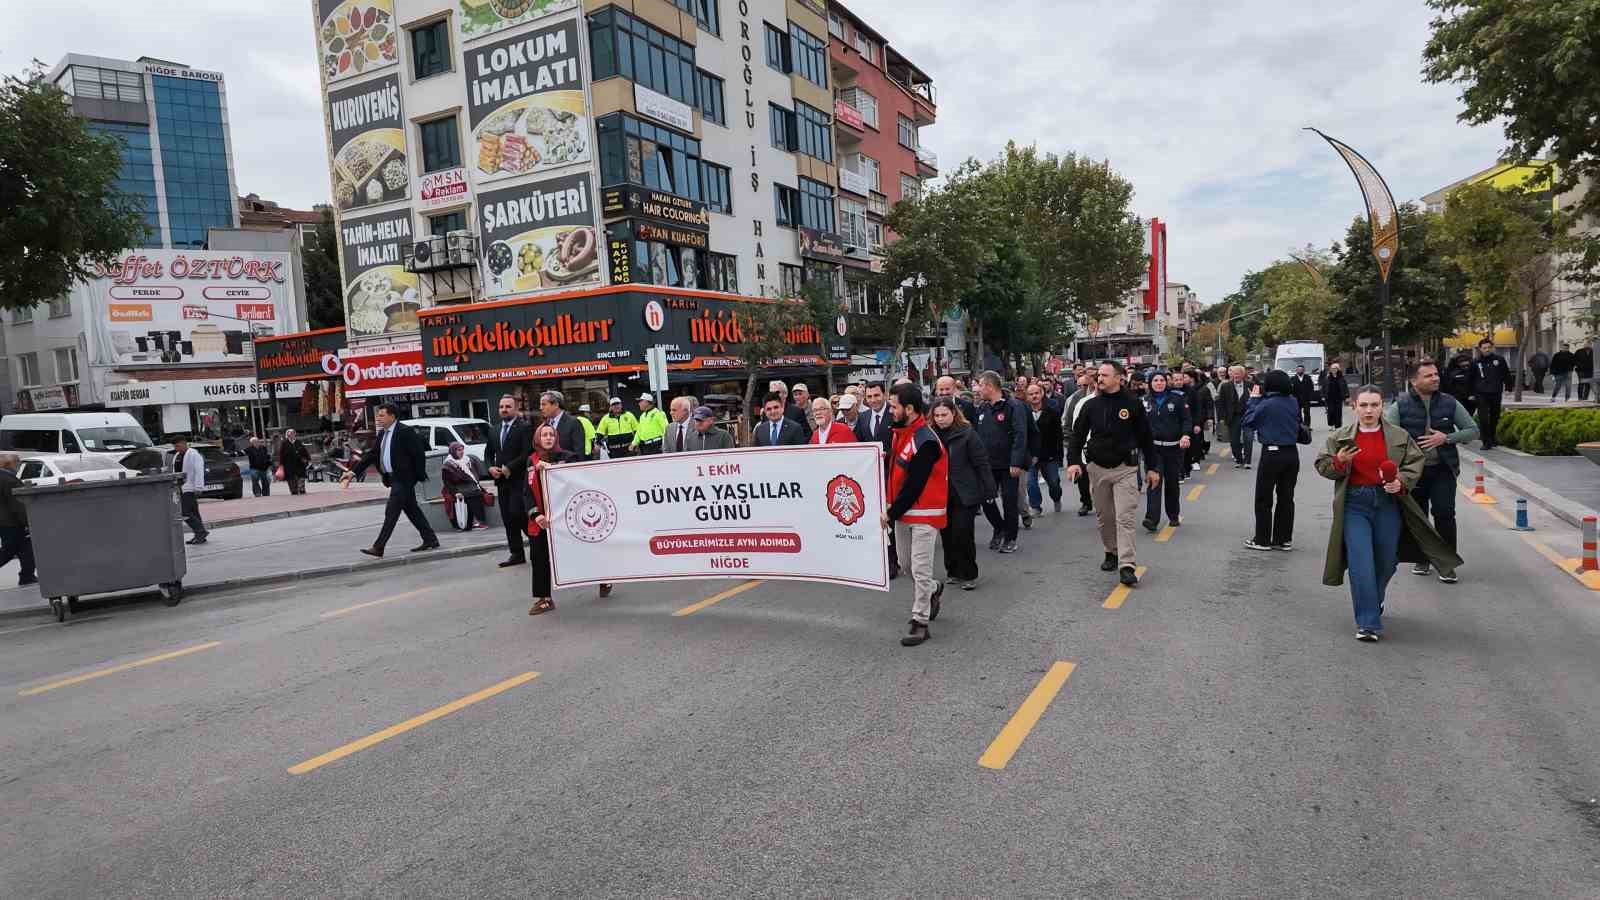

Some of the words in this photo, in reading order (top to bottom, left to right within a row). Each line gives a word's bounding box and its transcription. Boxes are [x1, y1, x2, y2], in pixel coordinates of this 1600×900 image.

[477, 30, 567, 77] LOKUM
[181, 70, 222, 81] BAROSU
[472, 58, 578, 106] İMALATI
[332, 80, 399, 131] KURUYEMİŞ
[751, 145, 759, 192] İŞ
[436, 186, 463, 196] Reklam
[651, 191, 671, 203] HAKAN
[483, 181, 588, 232] ŞARKÜTERİ
[642, 202, 660, 216] HAIR
[662, 207, 701, 224] COLORING
[343, 218, 410, 246] TAHİN-HELVA
[357, 243, 399, 266] İMALATI
[612, 242, 622, 282] BAYAN
[753, 219, 766, 296] HANI
[170, 255, 285, 284] ÖZTÜRK
[597, 351, 615, 359] SINCE
[360, 361, 422, 380] vodafone
[111, 388, 129, 400] KUAFÖR
[204, 383, 246, 396] KUAFÖR
[250, 382, 289, 394] SERAR
[696, 466, 704, 477] 1
[709, 462, 741, 477] EKİM
[636, 484, 706, 505] DÜNYA
[712, 482, 803, 502] YAŞLILAR
[695, 501, 751, 521] GÜNÜ
[656, 537, 735, 550] BÜYÜKLERİMİZLE
[737, 538, 757, 547] AYNI
[760, 537, 796, 547] ADIMDA
[710, 555, 749, 568] NİĞDE
